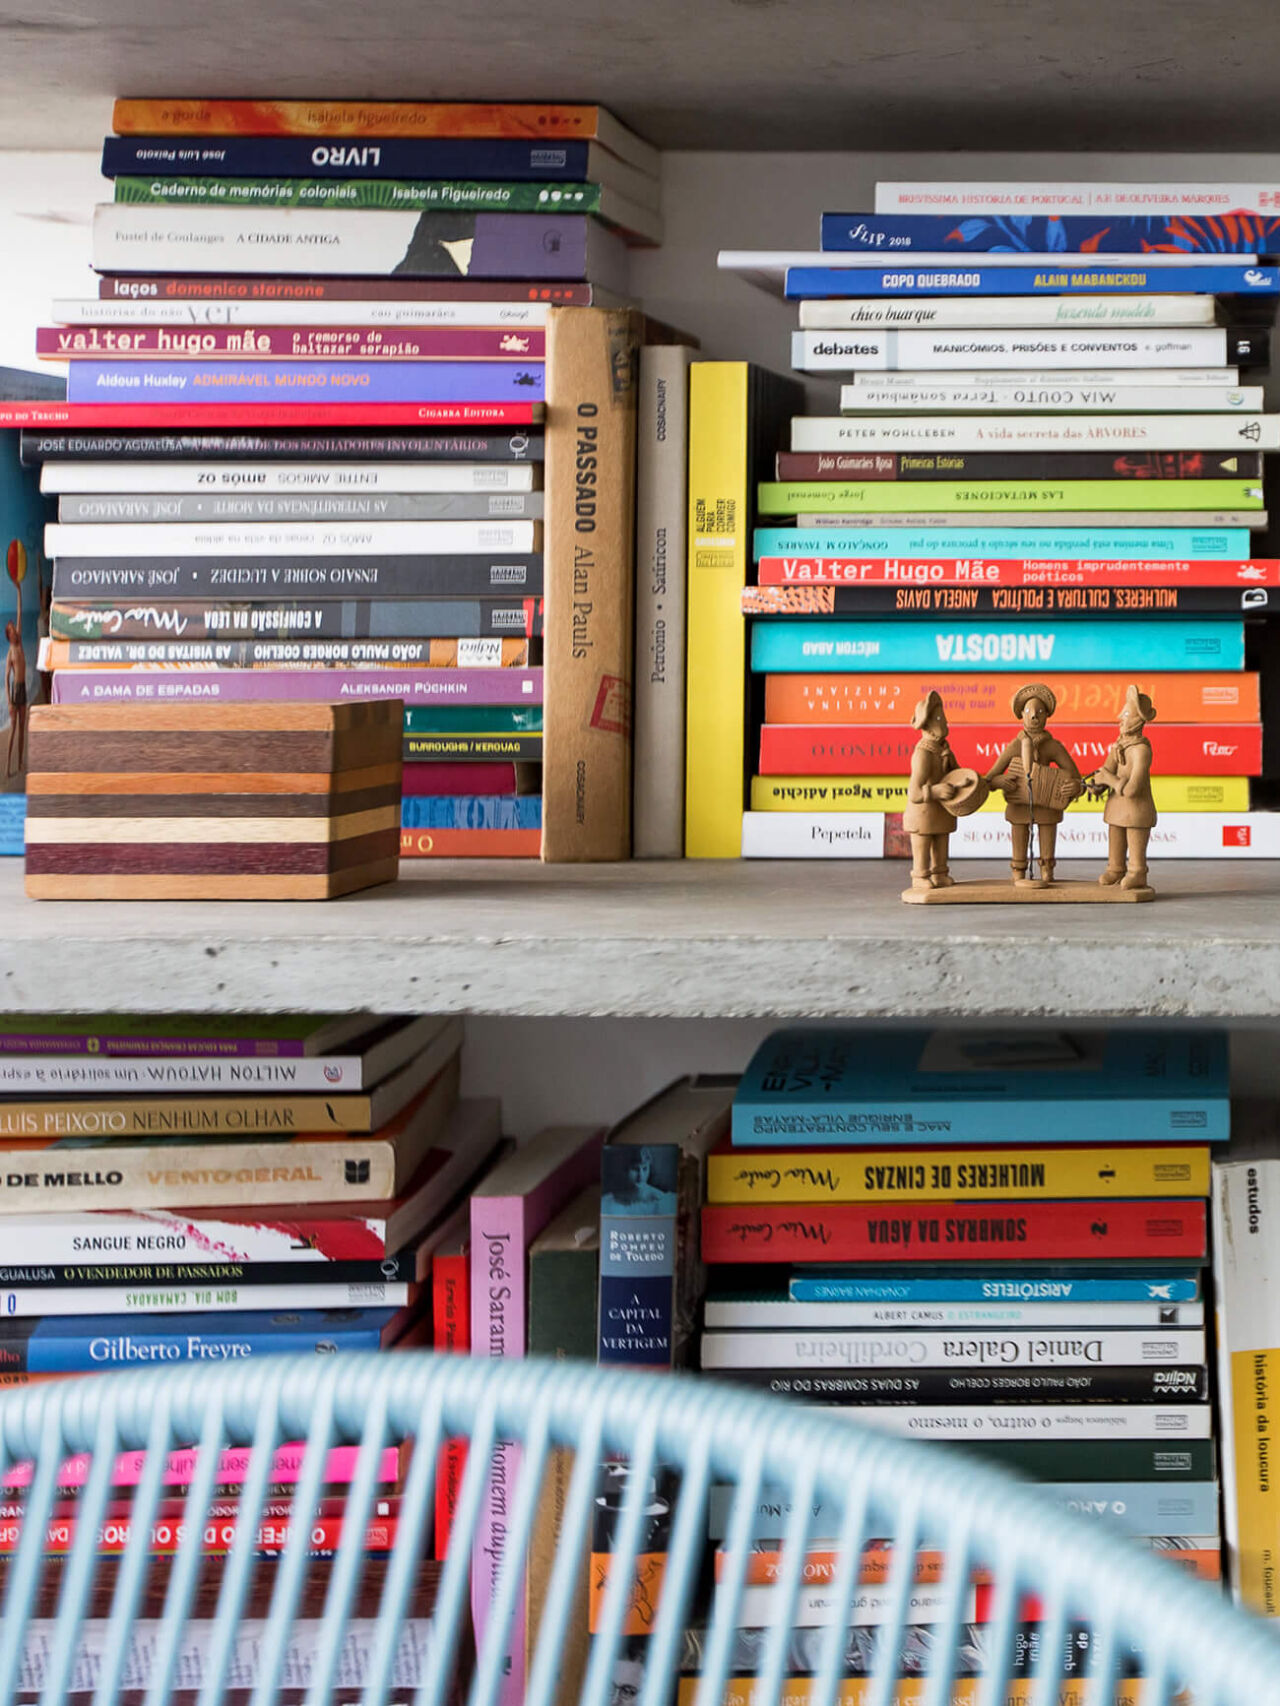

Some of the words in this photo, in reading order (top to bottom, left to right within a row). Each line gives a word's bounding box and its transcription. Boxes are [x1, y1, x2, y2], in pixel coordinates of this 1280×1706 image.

[312, 147, 380, 166] LIVRO
[151, 183, 207, 197] Caderno
[210, 184, 226, 196] de
[230, 184, 293, 198] memórias
[300, 186, 356, 199] coloniais
[393, 187, 438, 200] Isabela
[441, 188, 510, 202] Figueiredo
[890, 236, 912, 246] 2018
[114, 280, 158, 298] laços
[166, 280, 248, 295] domenico
[252, 282, 324, 296] starnone
[882, 273, 914, 288] COPO
[918, 272, 981, 288] QUEBRADO
[1034, 274, 1069, 288] ALAIN
[1072, 272, 1146, 287] MABANCKOU
[59, 330, 146, 351] valter
[158, 329, 216, 354] hugo
[227, 329, 270, 351] mãe
[812, 342, 879, 356] debates
[1012, 342, 1058, 352] PRISÕES
[1061, 344, 1067, 352] E
[1070, 343, 1138, 352] CONVENTOS
[97, 374, 140, 388] Aldous
[144, 374, 187, 390] Huxley
[194, 372, 270, 386] ADMIRÁVEL
[274, 374, 326, 386] MUNDO
[330, 374, 370, 386] NOVO
[1013, 391, 1074, 404] COUTO
[1080, 392, 1116, 404] MIA
[578, 404, 598, 417] O
[574, 426, 598, 532] PASSADO
[954, 491, 1038, 501] MUTACIONES
[1042, 490, 1064, 500] LAS
[284, 568, 326, 582] SOBRE
[329, 568, 378, 582] ENSAIO
[572, 546, 595, 596] Alan
[782, 558, 872, 581] Valter
[884, 559, 944, 584] Hugo
[955, 558, 1000, 581] Mãe
[1024, 559, 1068, 571] Homens
[1078, 559, 1190, 573] imprudentemente
[210, 569, 266, 583] LUCIDEZ
[272, 569, 280, 582] A
[1022, 570, 1084, 586] poéticos
[896, 589, 931, 610] DAVIS
[934, 589, 978, 609] ANGELA
[992, 589, 1044, 612] POLÍTICA
[1048, 589, 1054, 609] E
[1058, 588, 1110, 609] CULTURA
[204, 611, 229, 630] LEOA
[232, 611, 248, 630] DA
[250, 610, 312, 632] CONFISSÃO
[314, 610, 322, 629] A
[571, 602, 593, 659] Pauls
[650, 618, 667, 684] Petrônio
[802, 642, 834, 656] ABAD
[835, 640, 880, 658] HÉCTOR
[936, 634, 1055, 662] ANGOSTA
[340, 682, 410, 694] ALEKSANDR
[415, 681, 468, 694] PÚCHKIN
[803, 686, 901, 698] CHIZIANE
[808, 700, 894, 710] PAULINA
[812, 826, 872, 844] Pepetela
[146, 1066, 222, 1081] HATOUM
[230, 1066, 296, 1081] MILTON
[44, 1111, 126, 1131] PEIXOTO
[132, 1110, 219, 1128] NENHUM
[226, 1109, 295, 1128] OLHAR
[6, 1173, 38, 1186] DE
[44, 1170, 124, 1186] MELLO
[864, 1166, 924, 1190] CINZAS
[932, 1166, 952, 1188] DE
[957, 1164, 1044, 1188] MULHERES
[1248, 1168, 1262, 1235] estudos
[610, 1230, 665, 1242] ROBERTO
[868, 1220, 912, 1250] ÁGUA
[918, 1220, 940, 1242] DA
[945, 1218, 1026, 1243] SOMBRAS
[74, 1236, 132, 1250] SANGUE
[136, 1235, 186, 1250] NEGRO
[610, 1241, 665, 1252] POMPEU
[482, 1232, 511, 1280] José
[610, 1252, 622, 1262] DE
[625, 1251, 665, 1262] TOLEDO
[64, 1266, 76, 1280] O
[76, 1264, 159, 1280] VENDEDOR
[162, 1264, 176, 1278] DE
[178, 1264, 243, 1278] PASSADOS
[982, 1282, 1072, 1301] ARISTÓTELES
[630, 1296, 641, 1307] A
[608, 1308, 662, 1320] CAPITAL
[874, 1310, 906, 1320] ALBERT
[912, 1311, 944, 1320] CAMUS
[625, 1323, 645, 1336] DA
[90, 1338, 180, 1362] Gilberto
[186, 1336, 252, 1362] Freyre
[602, 1338, 669, 1350] VERTIGEM
[794, 1339, 928, 1364] Cordilheira
[942, 1340, 1020, 1363] Galera
[1028, 1340, 1102, 1363] Daniel
[1154, 1371, 1196, 1386] Ndjira
[1254, 1355, 1269, 1410] história
[1258, 1415, 1270, 1433] da
[1258, 1437, 1270, 1492] loucura
